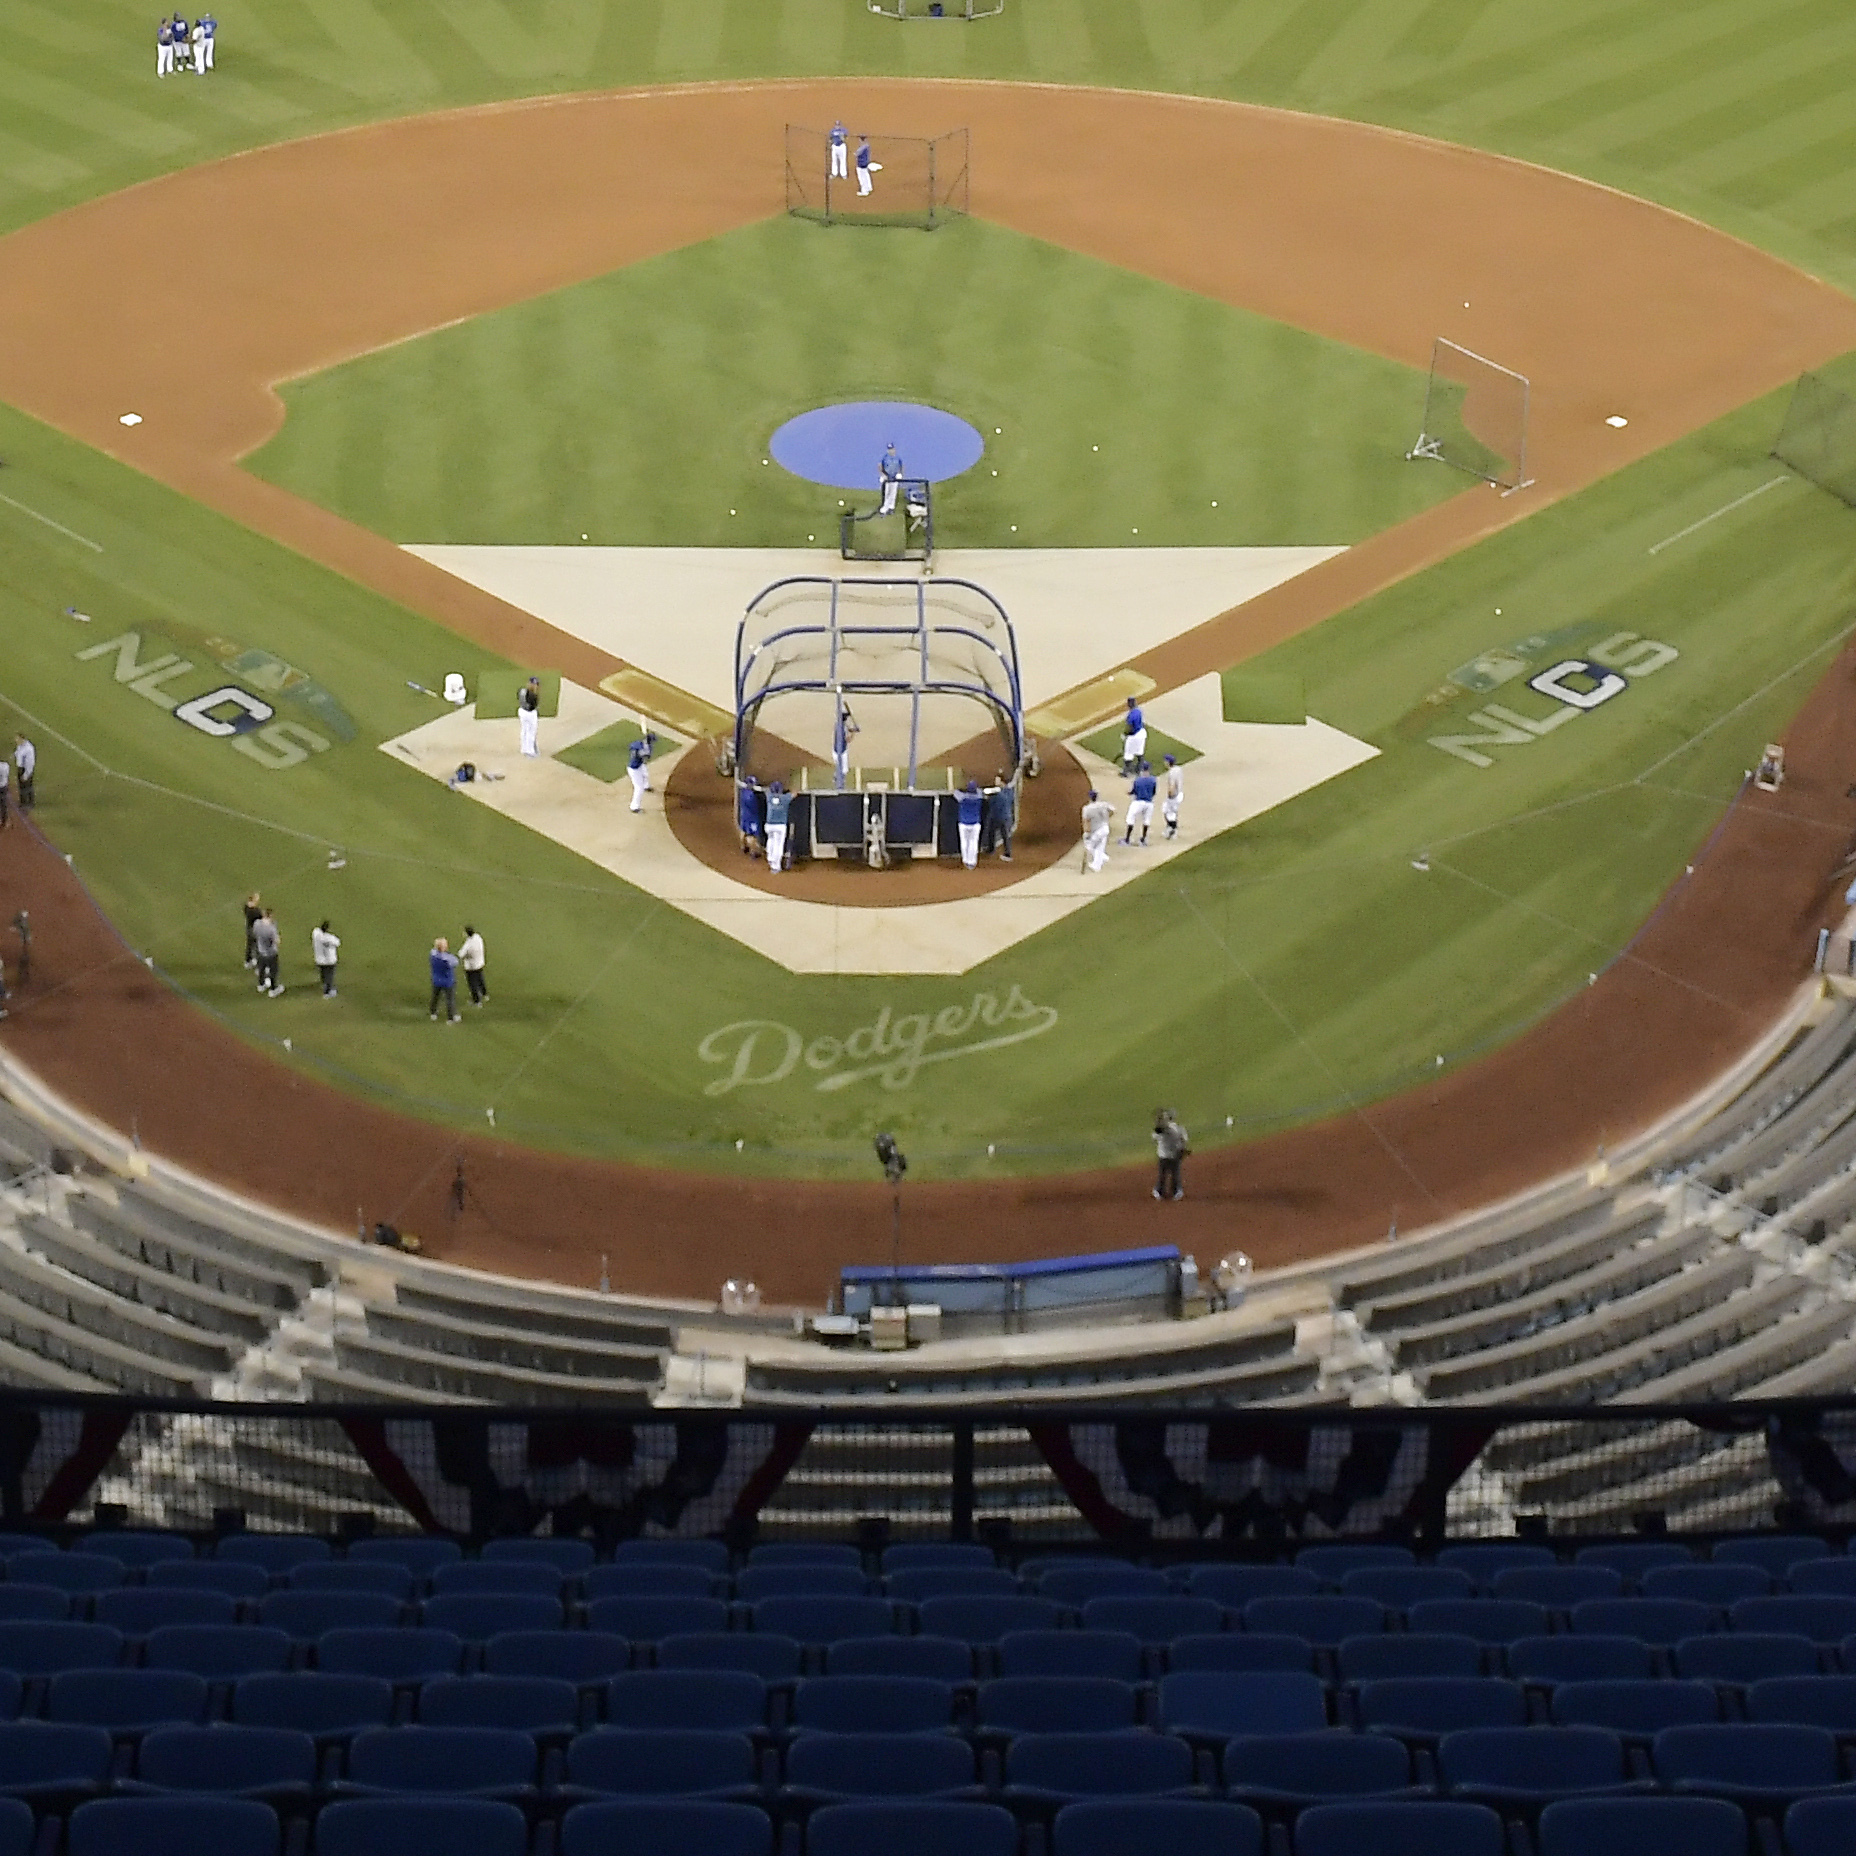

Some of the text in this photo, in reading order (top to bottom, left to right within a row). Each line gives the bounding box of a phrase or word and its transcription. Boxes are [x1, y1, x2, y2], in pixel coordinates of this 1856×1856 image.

[74, 631, 331, 769] NLCS
[1427, 631, 1679, 768] NLCS
[698, 985, 1058, 1096] Dodgers
